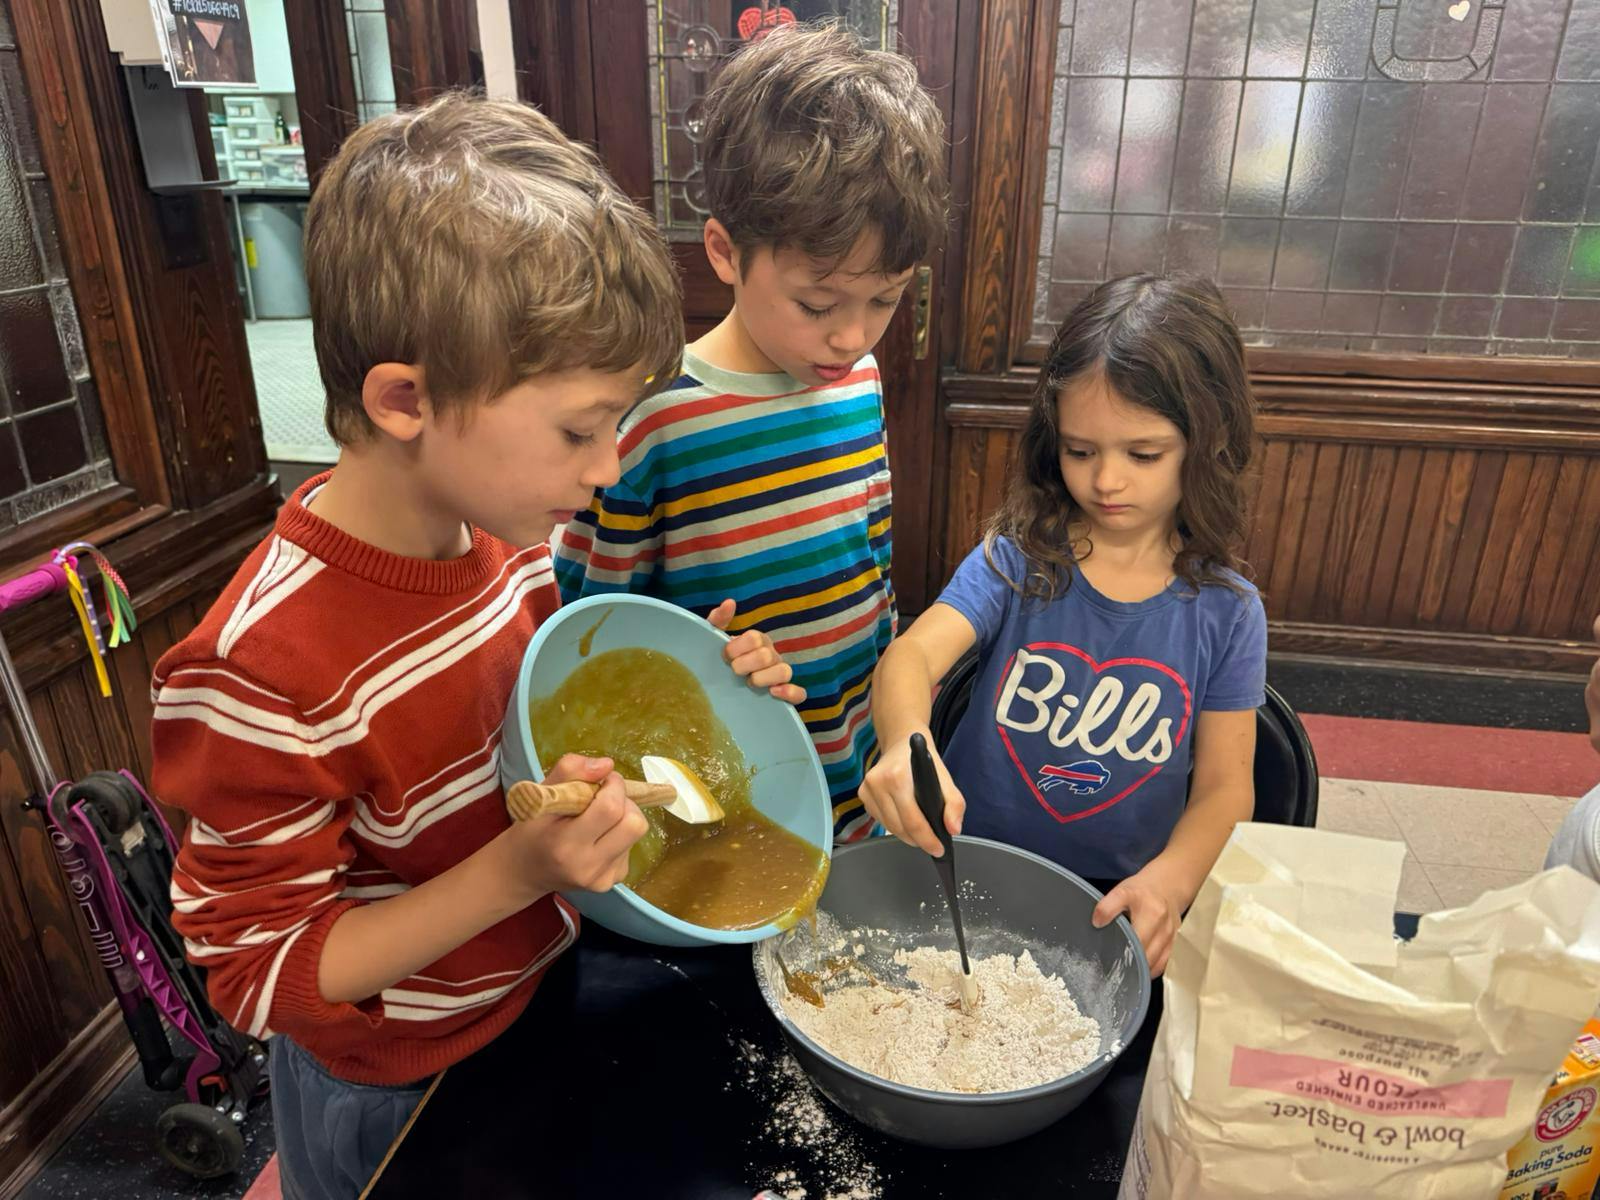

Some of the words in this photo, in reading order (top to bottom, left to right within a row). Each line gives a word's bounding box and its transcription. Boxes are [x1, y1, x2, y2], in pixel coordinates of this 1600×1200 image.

[996, 648, 1173, 764] Bills
[1338, 1048, 1403, 1070] purpose
[1408, 1066, 1431, 1079] all
[1296, 1080, 1362, 1106] ENRICHED
[1367, 1098, 1447, 1111] UNBLEACHED
[1373, 1126, 1399, 1147] &
[1404, 1125, 1466, 1150] bowl
[1505, 1158, 1554, 1181] Baking
[1556, 1144, 1594, 1164] Soda
[1540, 1144, 1564, 1160] pure
